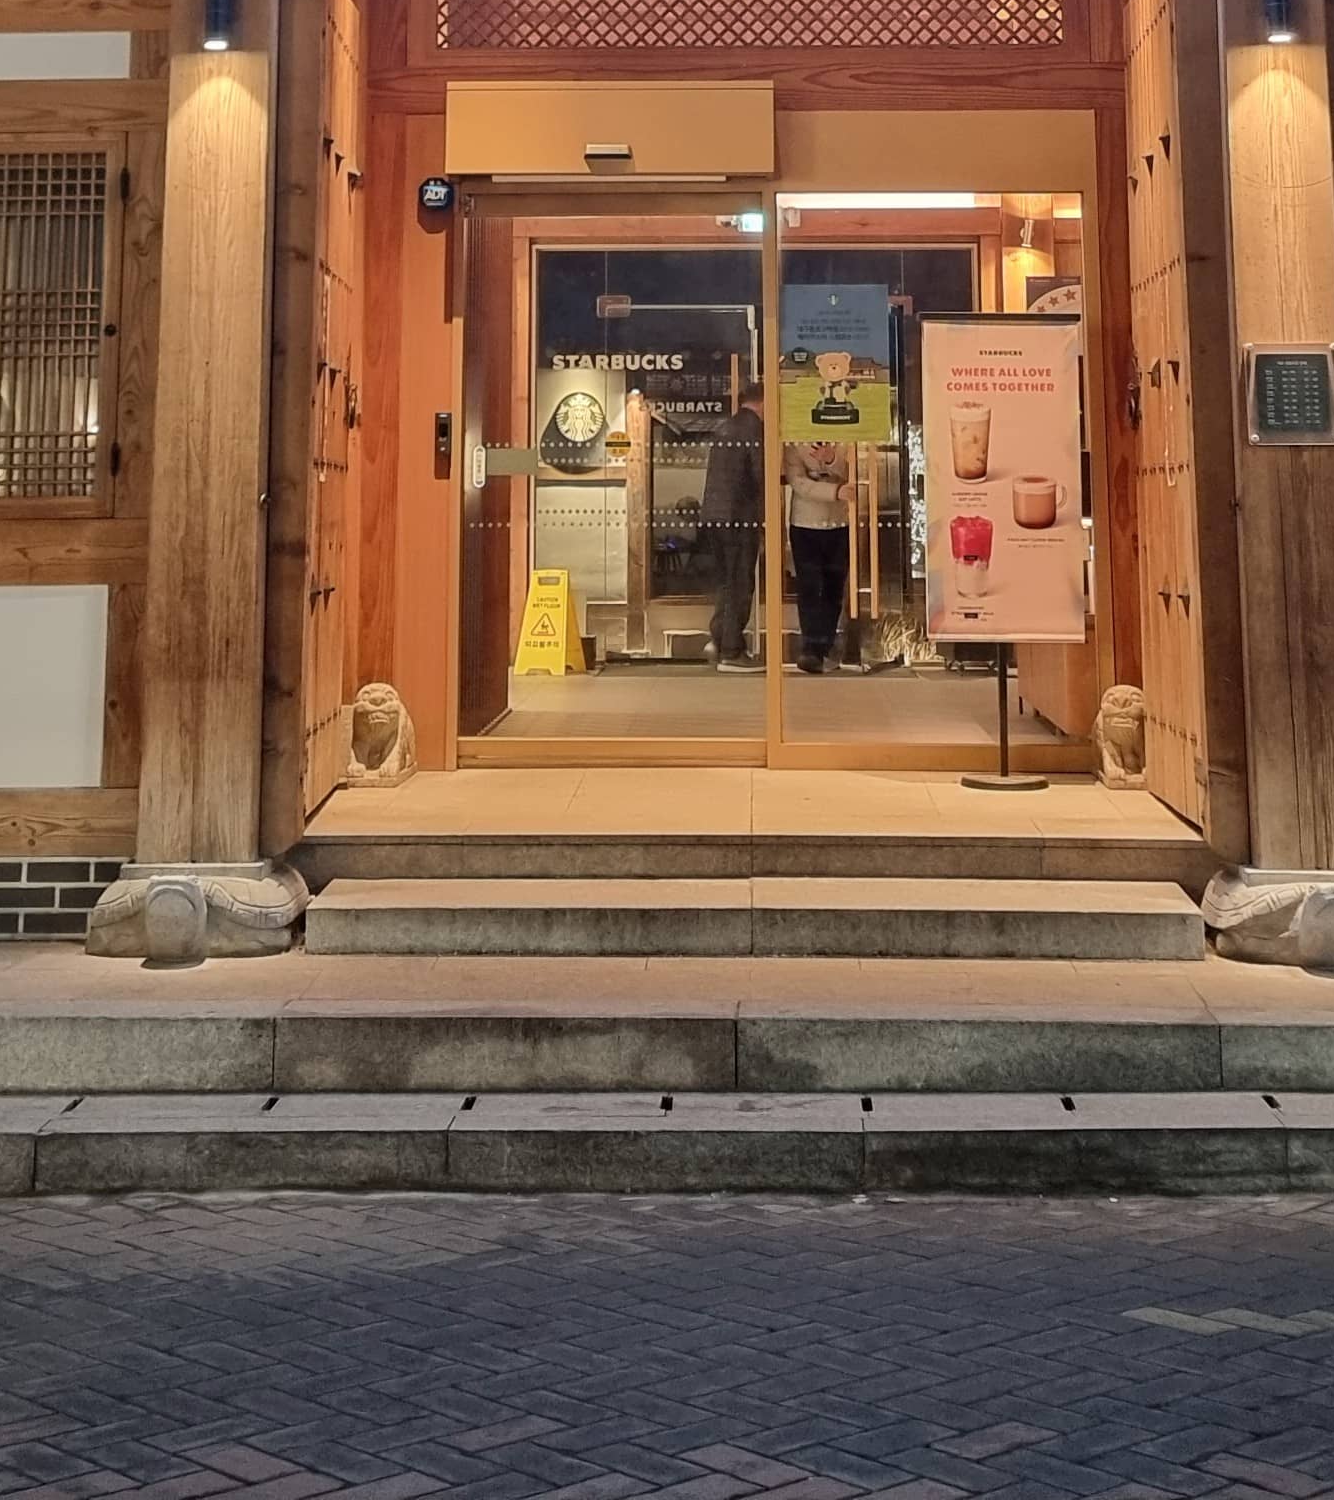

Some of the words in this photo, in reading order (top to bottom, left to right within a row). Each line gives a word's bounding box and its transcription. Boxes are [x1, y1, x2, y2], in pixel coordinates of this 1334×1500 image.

[552, 354, 684, 371] STARBUCKS
[951, 368, 995, 377] WHERE
[998, 368, 1019, 377] ALL
[1022, 368, 1052, 377] LOVE
[946, 382, 988, 391] COMES
[992, 382, 1055, 392] TOGETHER
